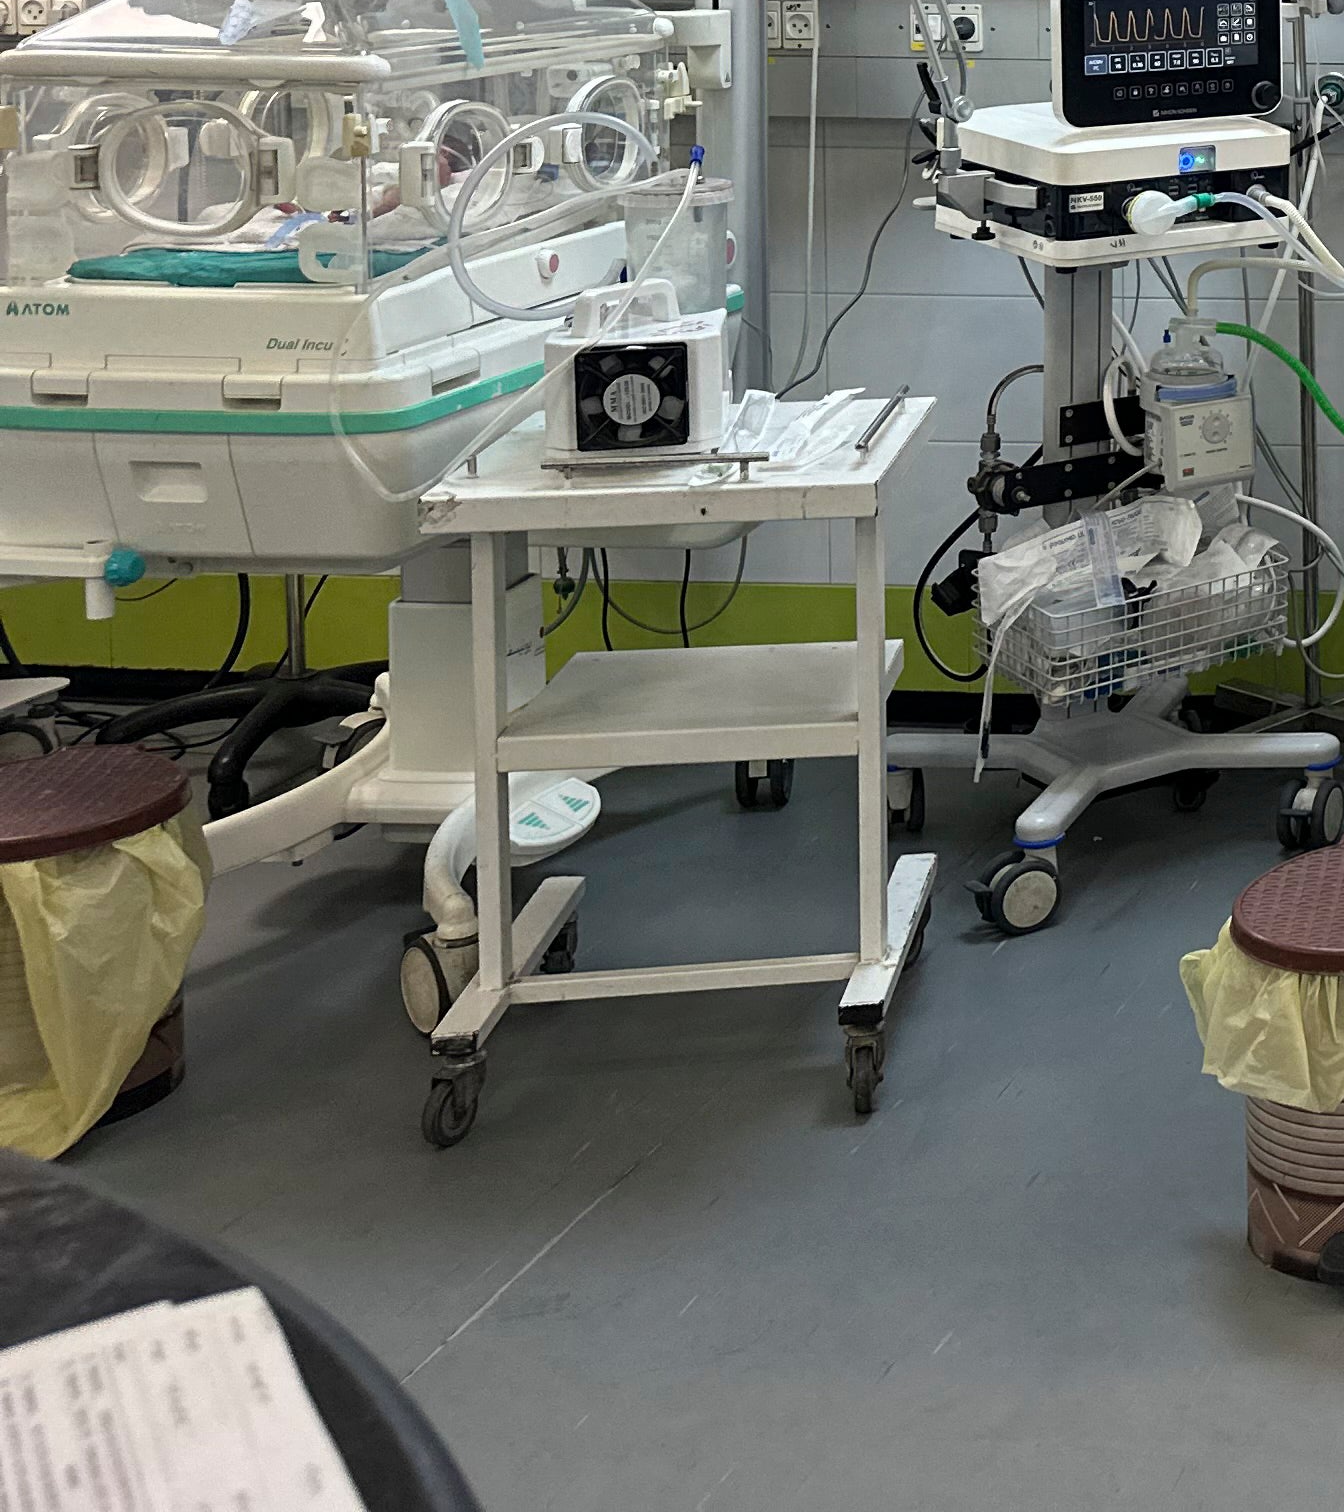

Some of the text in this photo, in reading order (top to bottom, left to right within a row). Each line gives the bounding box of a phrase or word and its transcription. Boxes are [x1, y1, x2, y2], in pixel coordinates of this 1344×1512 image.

[1070, 195, 1102, 203] NKV-550
[22, 304, 70, 316] ATOM
[266, 338, 300, 351] Dual
